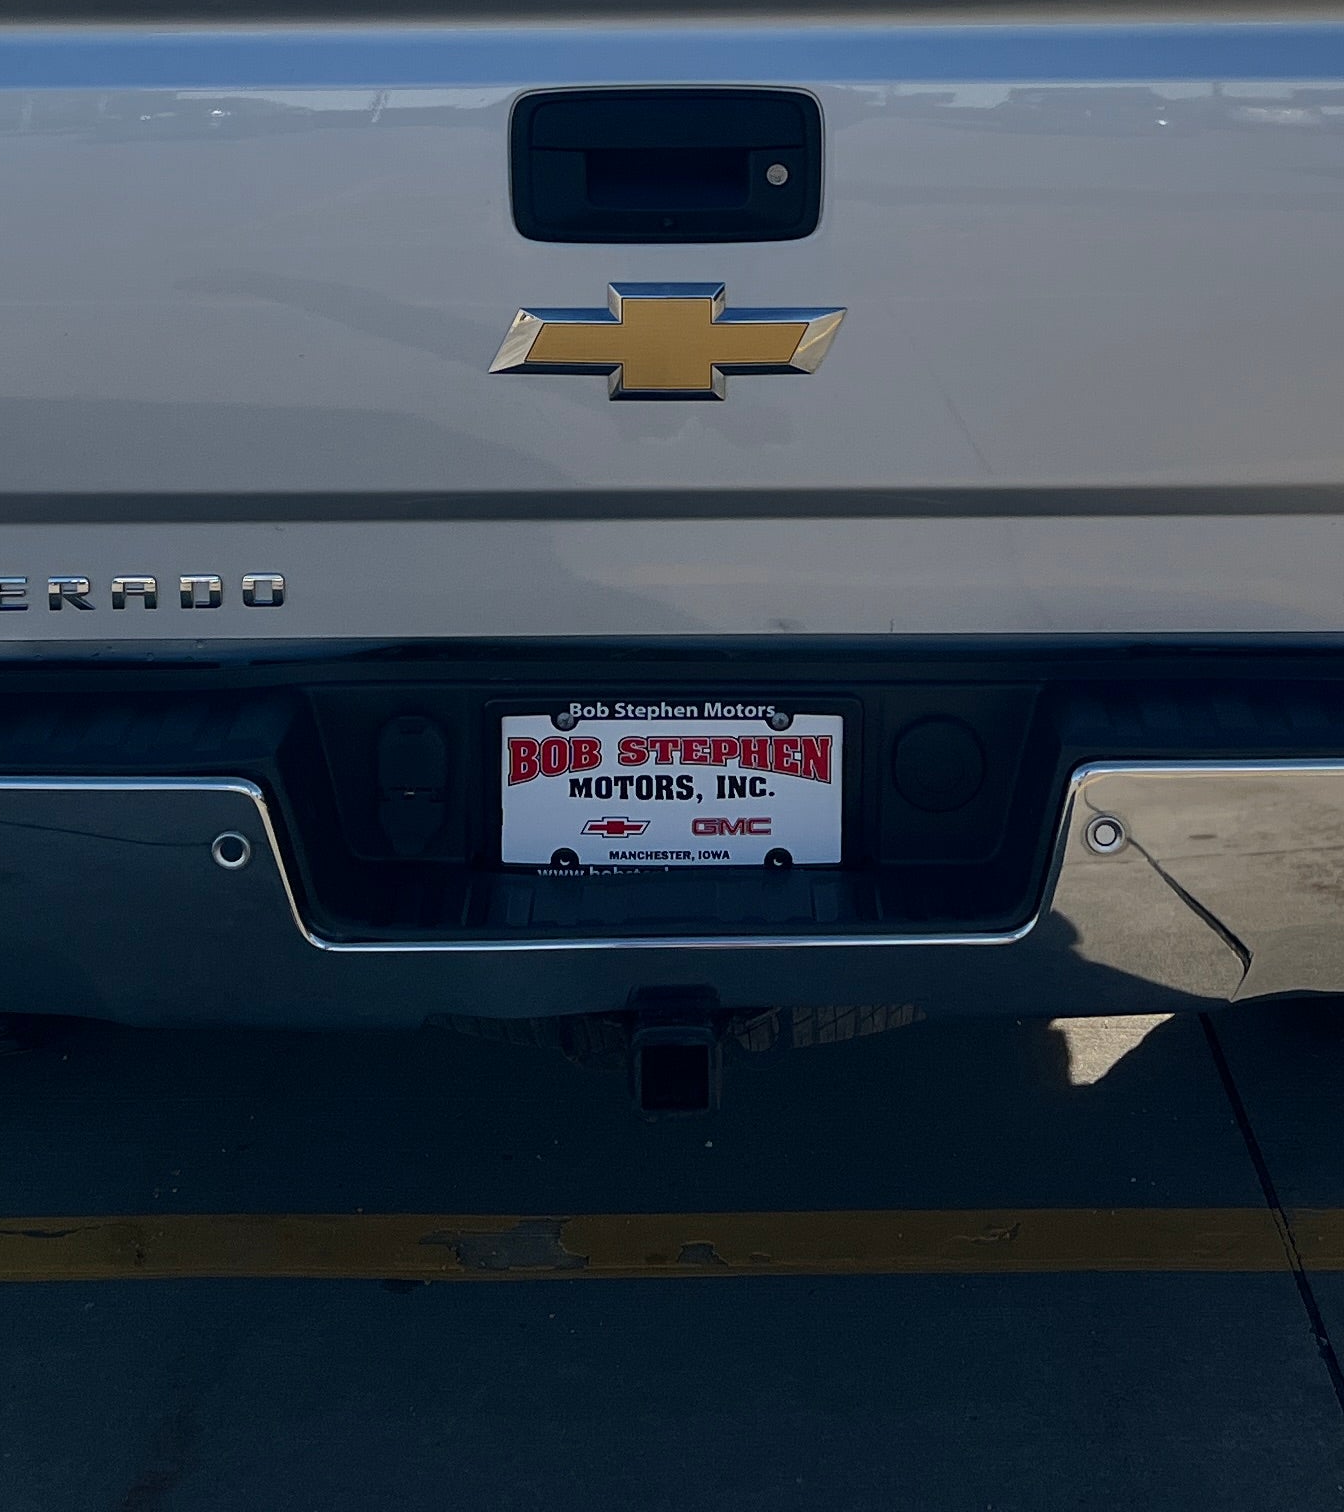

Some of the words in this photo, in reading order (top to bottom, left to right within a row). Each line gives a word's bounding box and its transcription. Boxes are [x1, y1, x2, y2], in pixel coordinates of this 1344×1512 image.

[569, 702, 609, 718] Bob
[614, 702, 699, 720] Stephen
[704, 703, 775, 718] Motors
[508, 736, 602, 786] BOB
[618, 736, 832, 784] STEPHEN
[569, 774, 703, 804] MOTORS,
[716, 775, 776, 799] INC.
[691, 817, 772, 836] GMC
[609, 850, 695, 862] MANCHESTER,
[698, 850, 730, 860] IOWA
